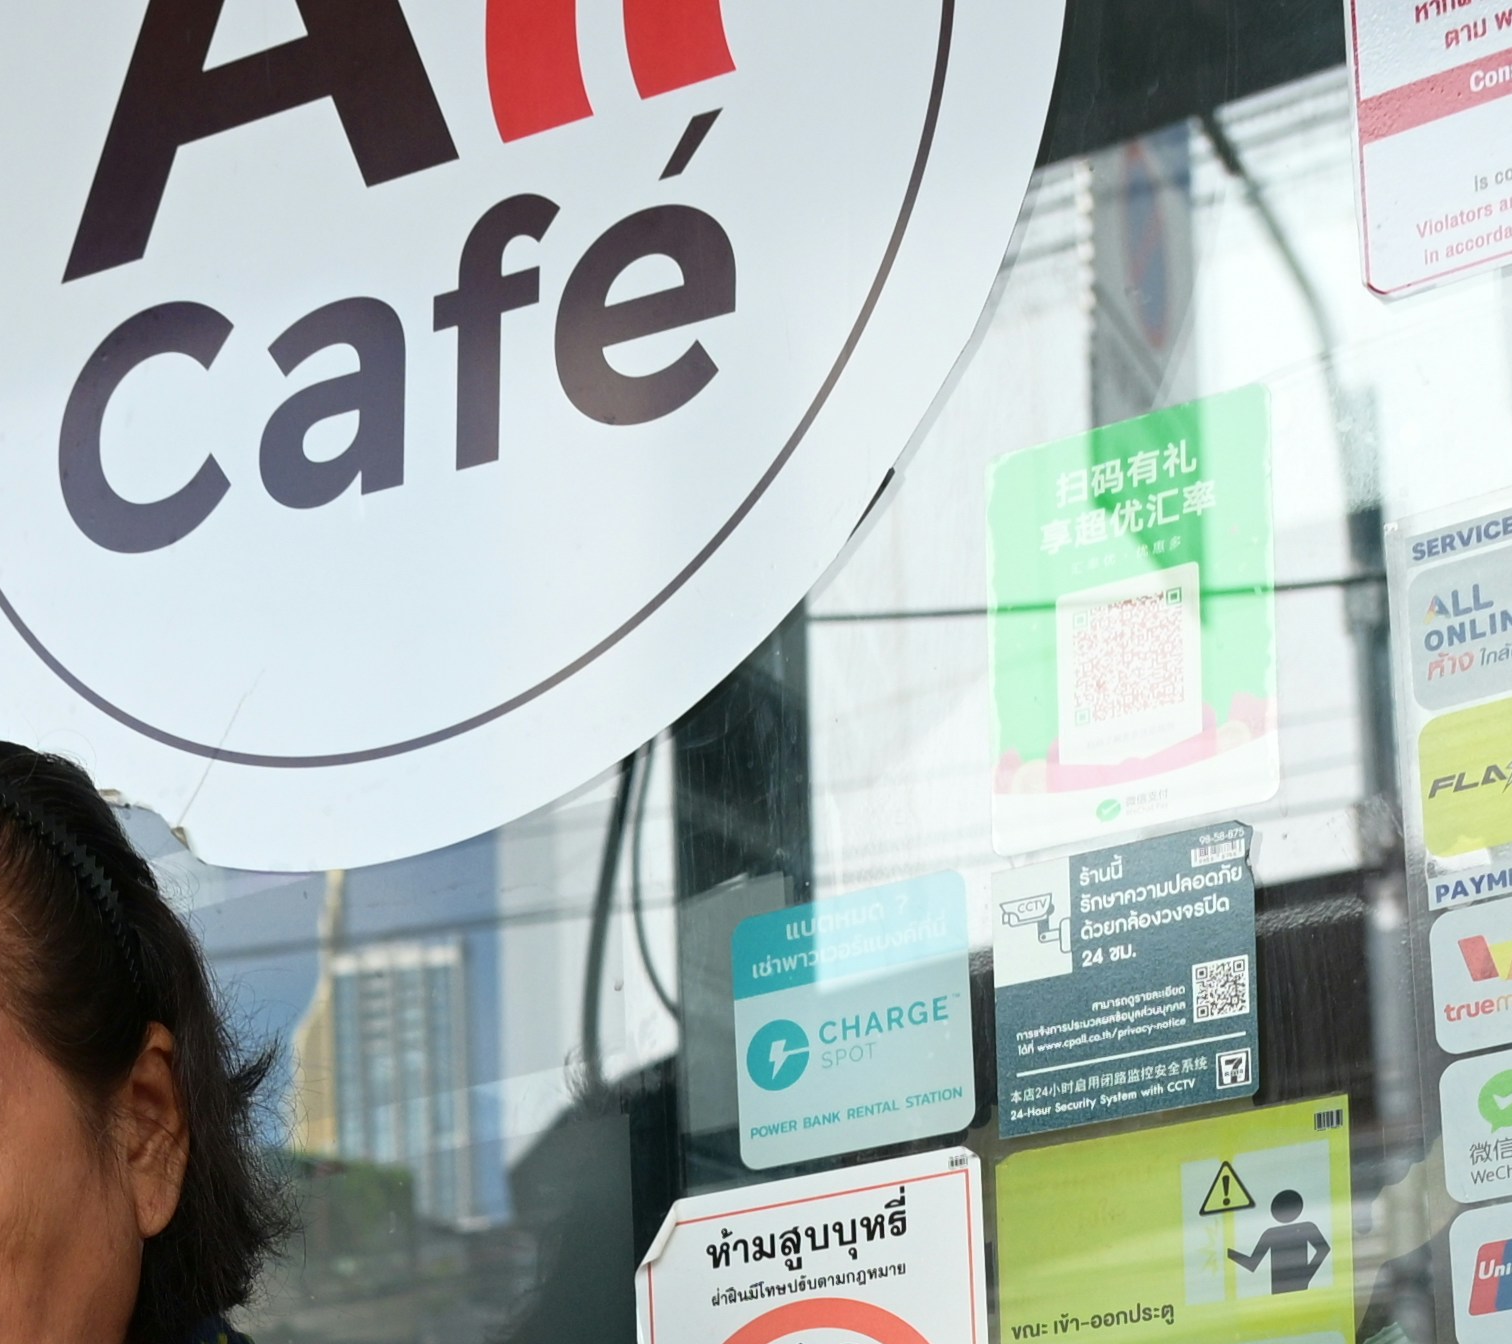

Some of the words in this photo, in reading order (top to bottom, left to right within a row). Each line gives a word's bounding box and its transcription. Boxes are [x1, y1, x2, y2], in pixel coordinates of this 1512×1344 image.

[1474, 175, 1488, 191] is
[1416, 202, 1493, 239] Violators
[1424, 248, 1439, 265] in
[58, 107, 737, 556] Café
[1056, 438, 1198, 508] 扫码有礼
[1040, 479, 1217, 555] 享超优汇率
[1423, 583, 1494, 625] ALL
[1428, 652, 1474, 681] ห้าง
[1080, 855, 1122, 886] ร้านนี้
[1080, 863, 1243, 913] รักษาความปลอดภัย
[1018, 898, 1046, 914] CCTV
[1081, 896, 1230, 940] ด้วยกล้องวงจรปิด
[1082, 950, 1103, 967] 24
[1109, 943, 1136, 964] ชม.
[819, 996, 949, 1045] CHARGE
[821, 1042, 877, 1069] SPOT
[1010, 1056, 1208, 1104] 本店24小时启用闭路监控安全系统
[1011, 1104, 1051, 1121] 24-Hour
[1055, 1096, 1097, 1113] Security
[1100, 1090, 1137, 1106] System
[1141, 1085, 1164, 1098] with
[1167, 1078, 1196, 1093] CCTV
[750, 1119, 797, 1140] POWER
[803, 1111, 840, 1129] BANK
[847, 1100, 899, 1120] RENTAL
[906, 1086, 963, 1109] STATION
[706, 1186, 907, 1271] ห้ามสูบบุหรี่
[1011, 1322, 1048, 1340] ขณะ
[1054, 1302, 1175, 1335] เข้า-ออกประตู
